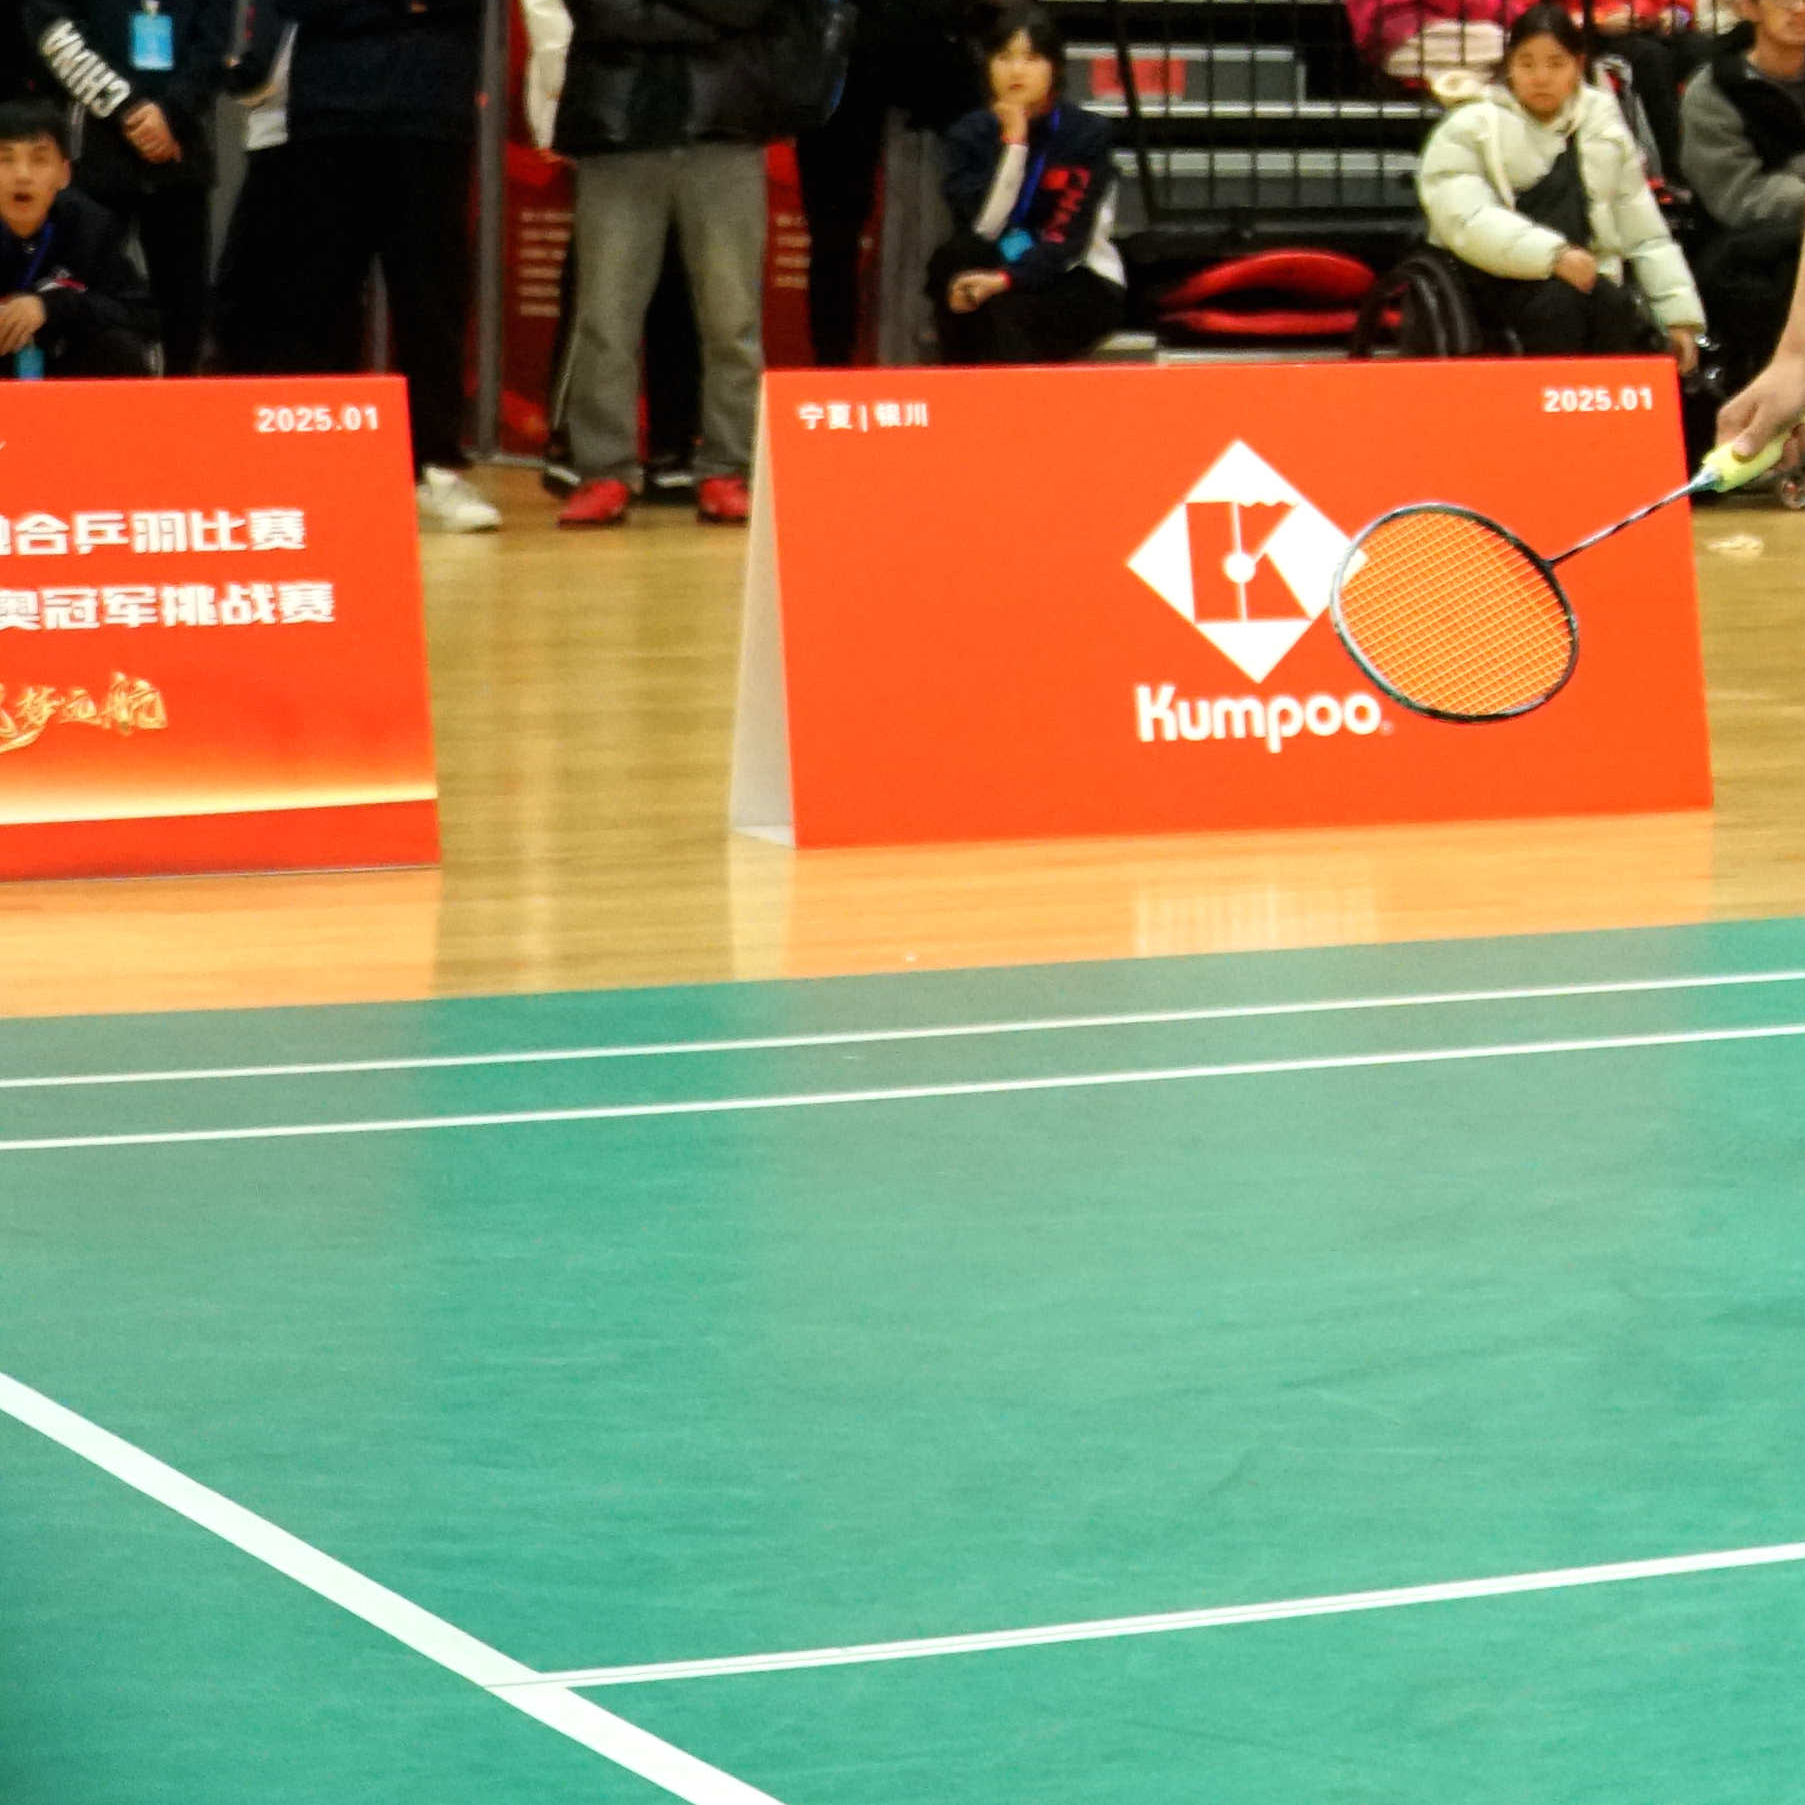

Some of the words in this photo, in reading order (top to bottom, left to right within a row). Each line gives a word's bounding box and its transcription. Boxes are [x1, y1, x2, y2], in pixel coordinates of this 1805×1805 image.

[1543, 386, 1653, 414] 2025.01
[256, 405, 379, 433] 2025.01
[1135, 682, 1382, 754] Kumpoo
